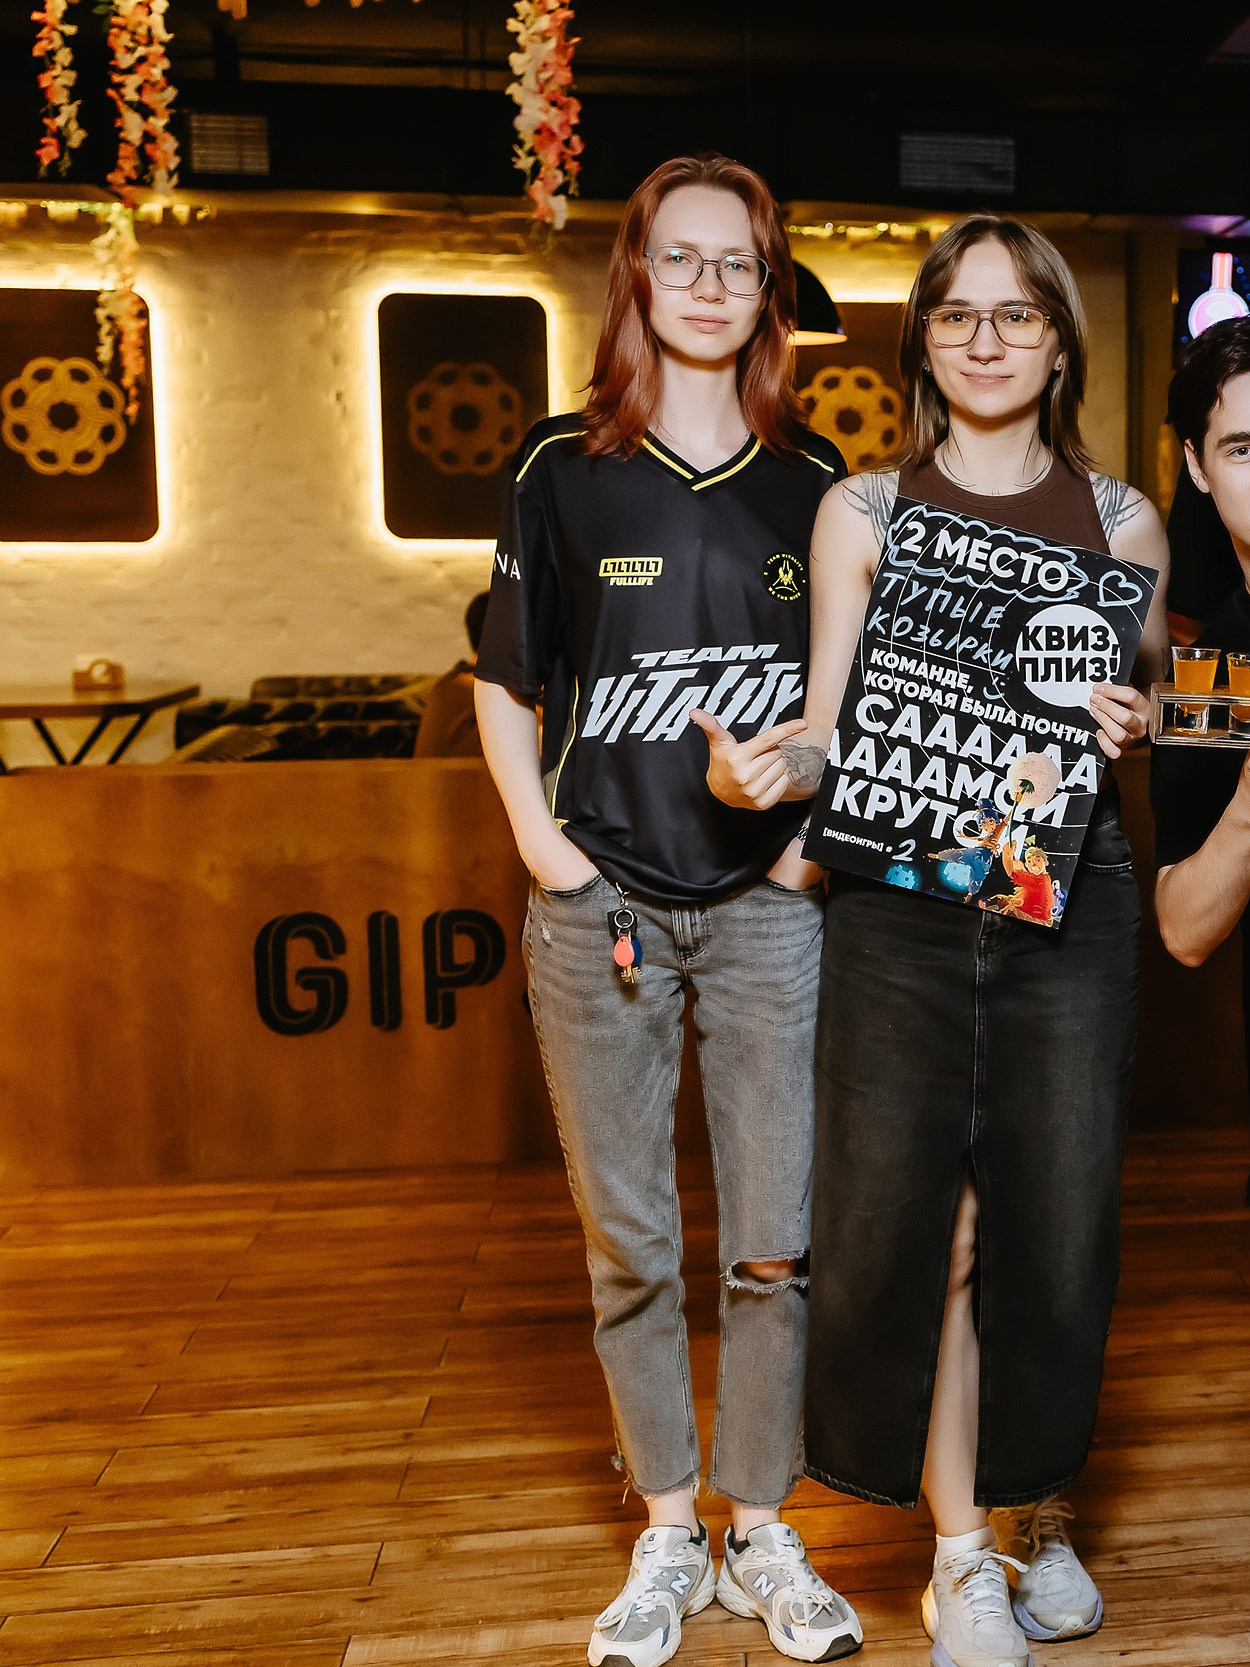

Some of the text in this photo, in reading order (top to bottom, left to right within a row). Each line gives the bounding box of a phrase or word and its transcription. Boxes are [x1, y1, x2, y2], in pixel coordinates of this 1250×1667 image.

[901, 521, 1069, 592] 2 МЕСТО
[880, 572, 1007, 629] ТУПЫЕ
[630, 643, 780, 669] TEAM
[867, 606, 1013, 670] КОЗЫРКИ
[1021, 624, 1120, 656] КВИЗ,
[870, 648, 974, 694] КОМАНДЕ,
[1019, 656, 1119, 685] ПЛИЗ!
[864, 669, 1090, 747] КОТОРАЯ БЫЛА ПОЧТИ
[822, 827, 884, 852] [ВИДЕОИГРЫ]
[892, 838, 916, 862] 2
[254, 909, 530, 1036] GIP
